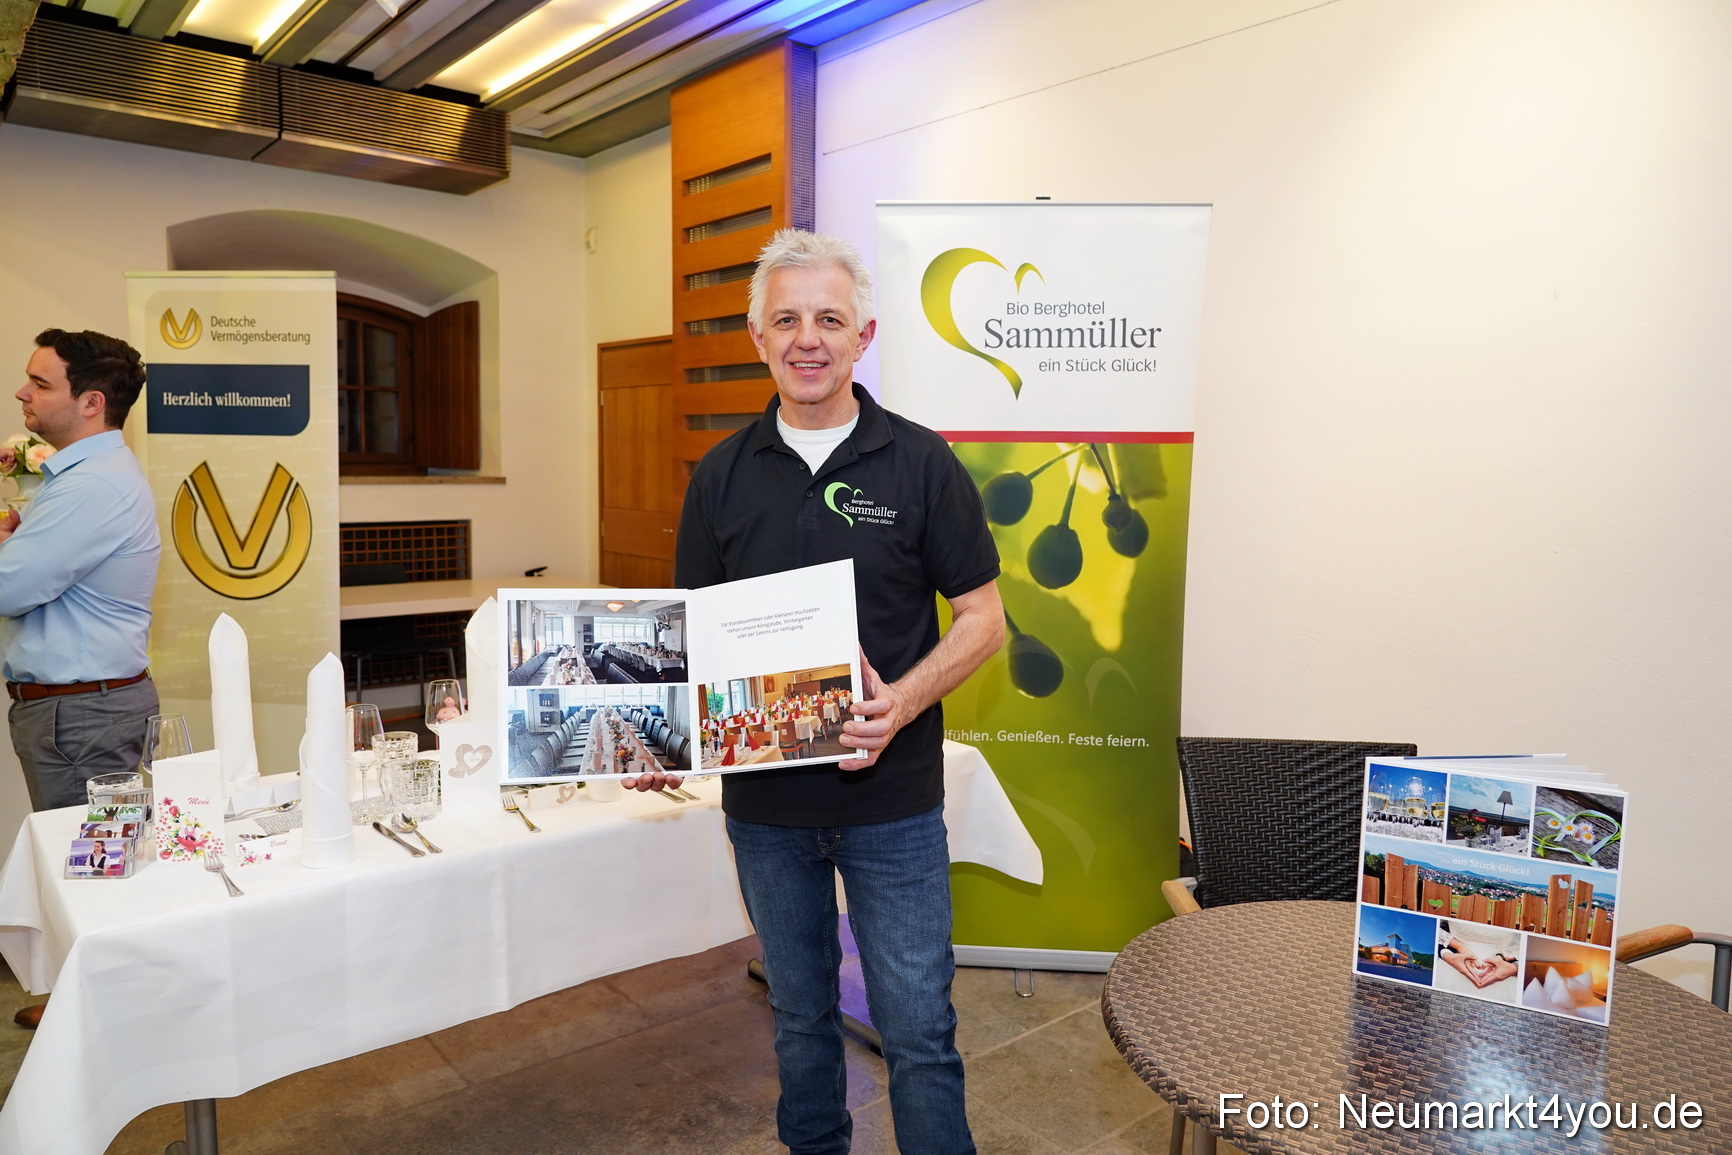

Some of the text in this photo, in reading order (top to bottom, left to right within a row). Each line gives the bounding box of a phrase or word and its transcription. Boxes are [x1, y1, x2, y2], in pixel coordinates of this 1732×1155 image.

[1006, 301, 1105, 318] Bio Berghotel
[210, 315, 256, 328] Deutsche
[210, 330, 311, 345] Vermögensberatung
[984, 317, 1162, 349] Sammüller
[1038, 358, 1157, 372] ein Stück Glück!
[162, 391, 291, 408] Herzlich willkommen!
[842, 502, 897, 518] Sammüller
[943, 729, 1150, 748] lfühlen. Genießen. Feste feiern.
[187, 796, 211, 806] Menü
[1452, 857, 1468, 865] ein
[1470, 858, 1496, 871] Stück
[1498, 864, 1530, 876] Glück!
